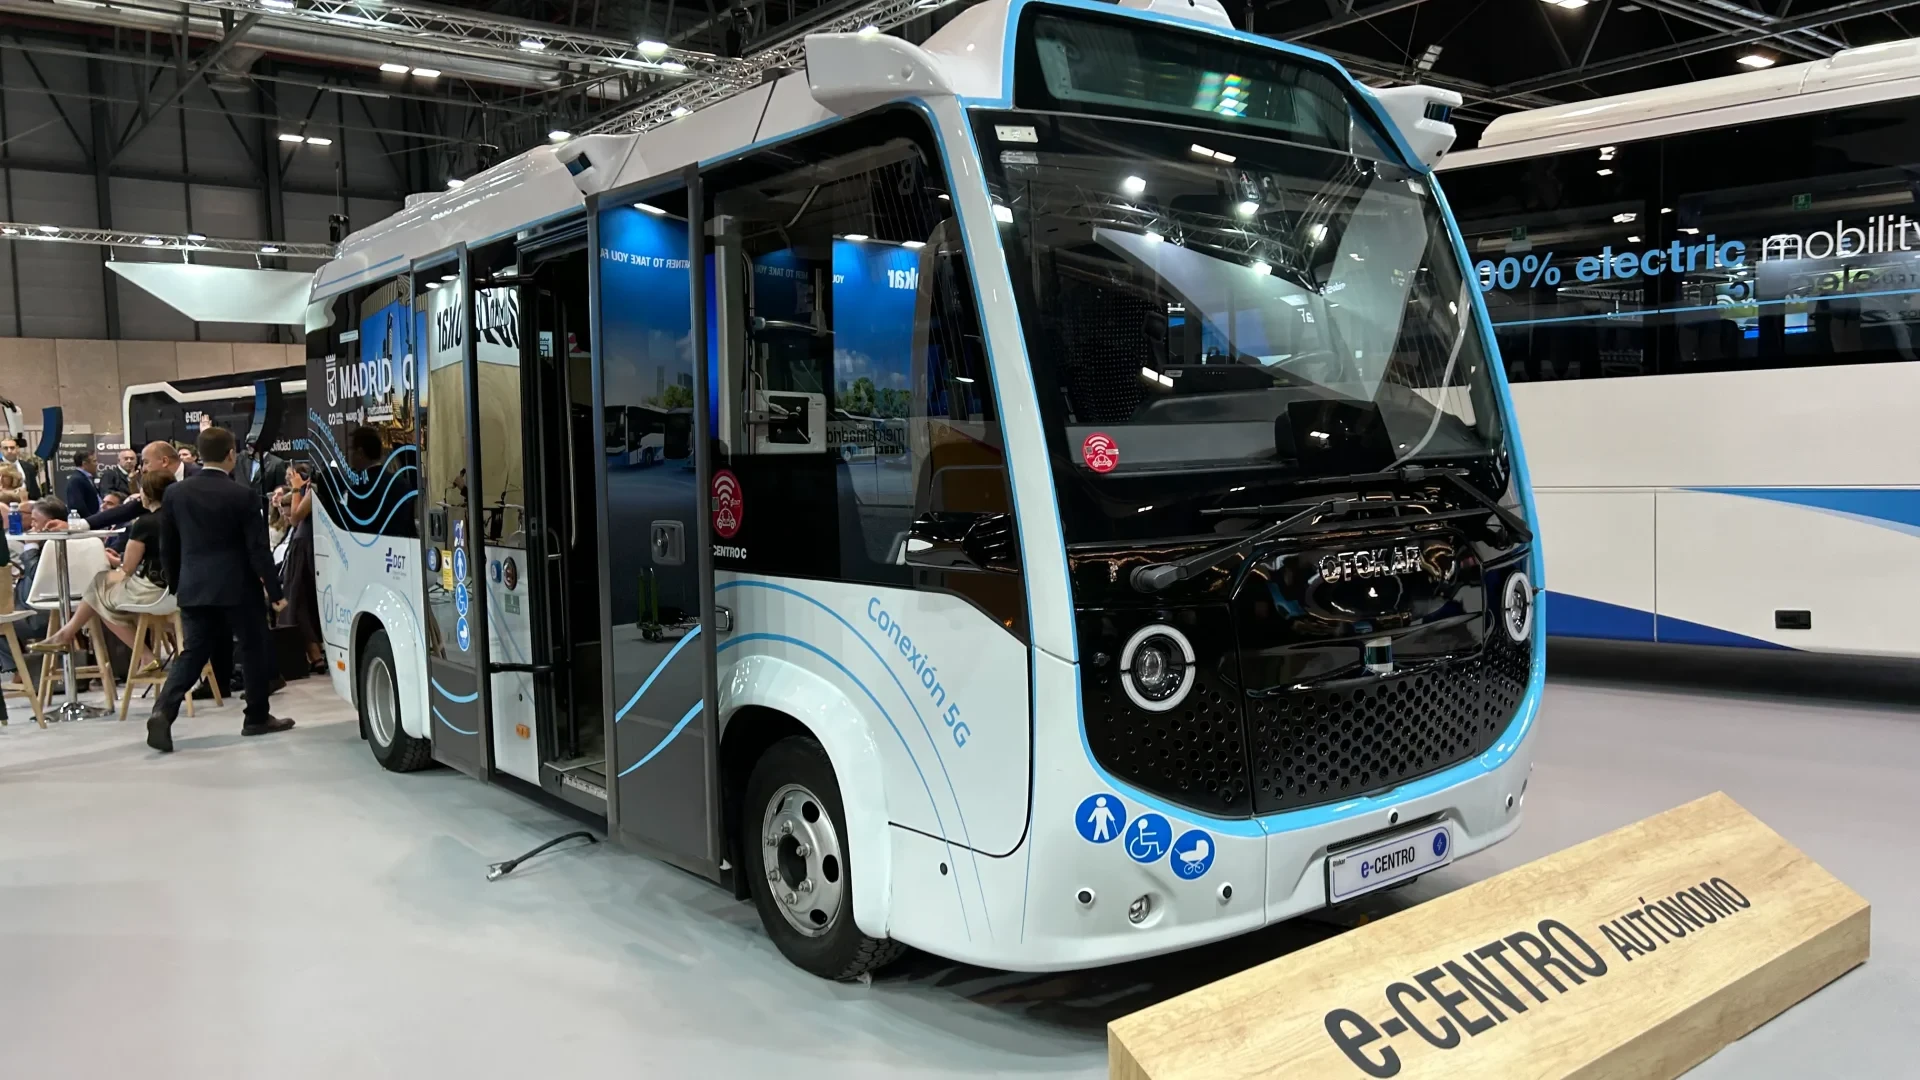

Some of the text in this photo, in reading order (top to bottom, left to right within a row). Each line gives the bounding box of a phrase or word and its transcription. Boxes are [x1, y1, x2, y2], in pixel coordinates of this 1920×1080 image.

[1575, 234, 1746, 282] electric
[340, 358, 392, 402] MADRID
[393, 554, 406, 570] DGT
[1319, 546, 1422, 583] OTOKAR
[867, 597, 971, 748] Conexión 5G
[1361, 846, 1416, 878] e-CENTRO
[1324, 877, 1751, 1079] e-CENTRO AUTÓNOMO
